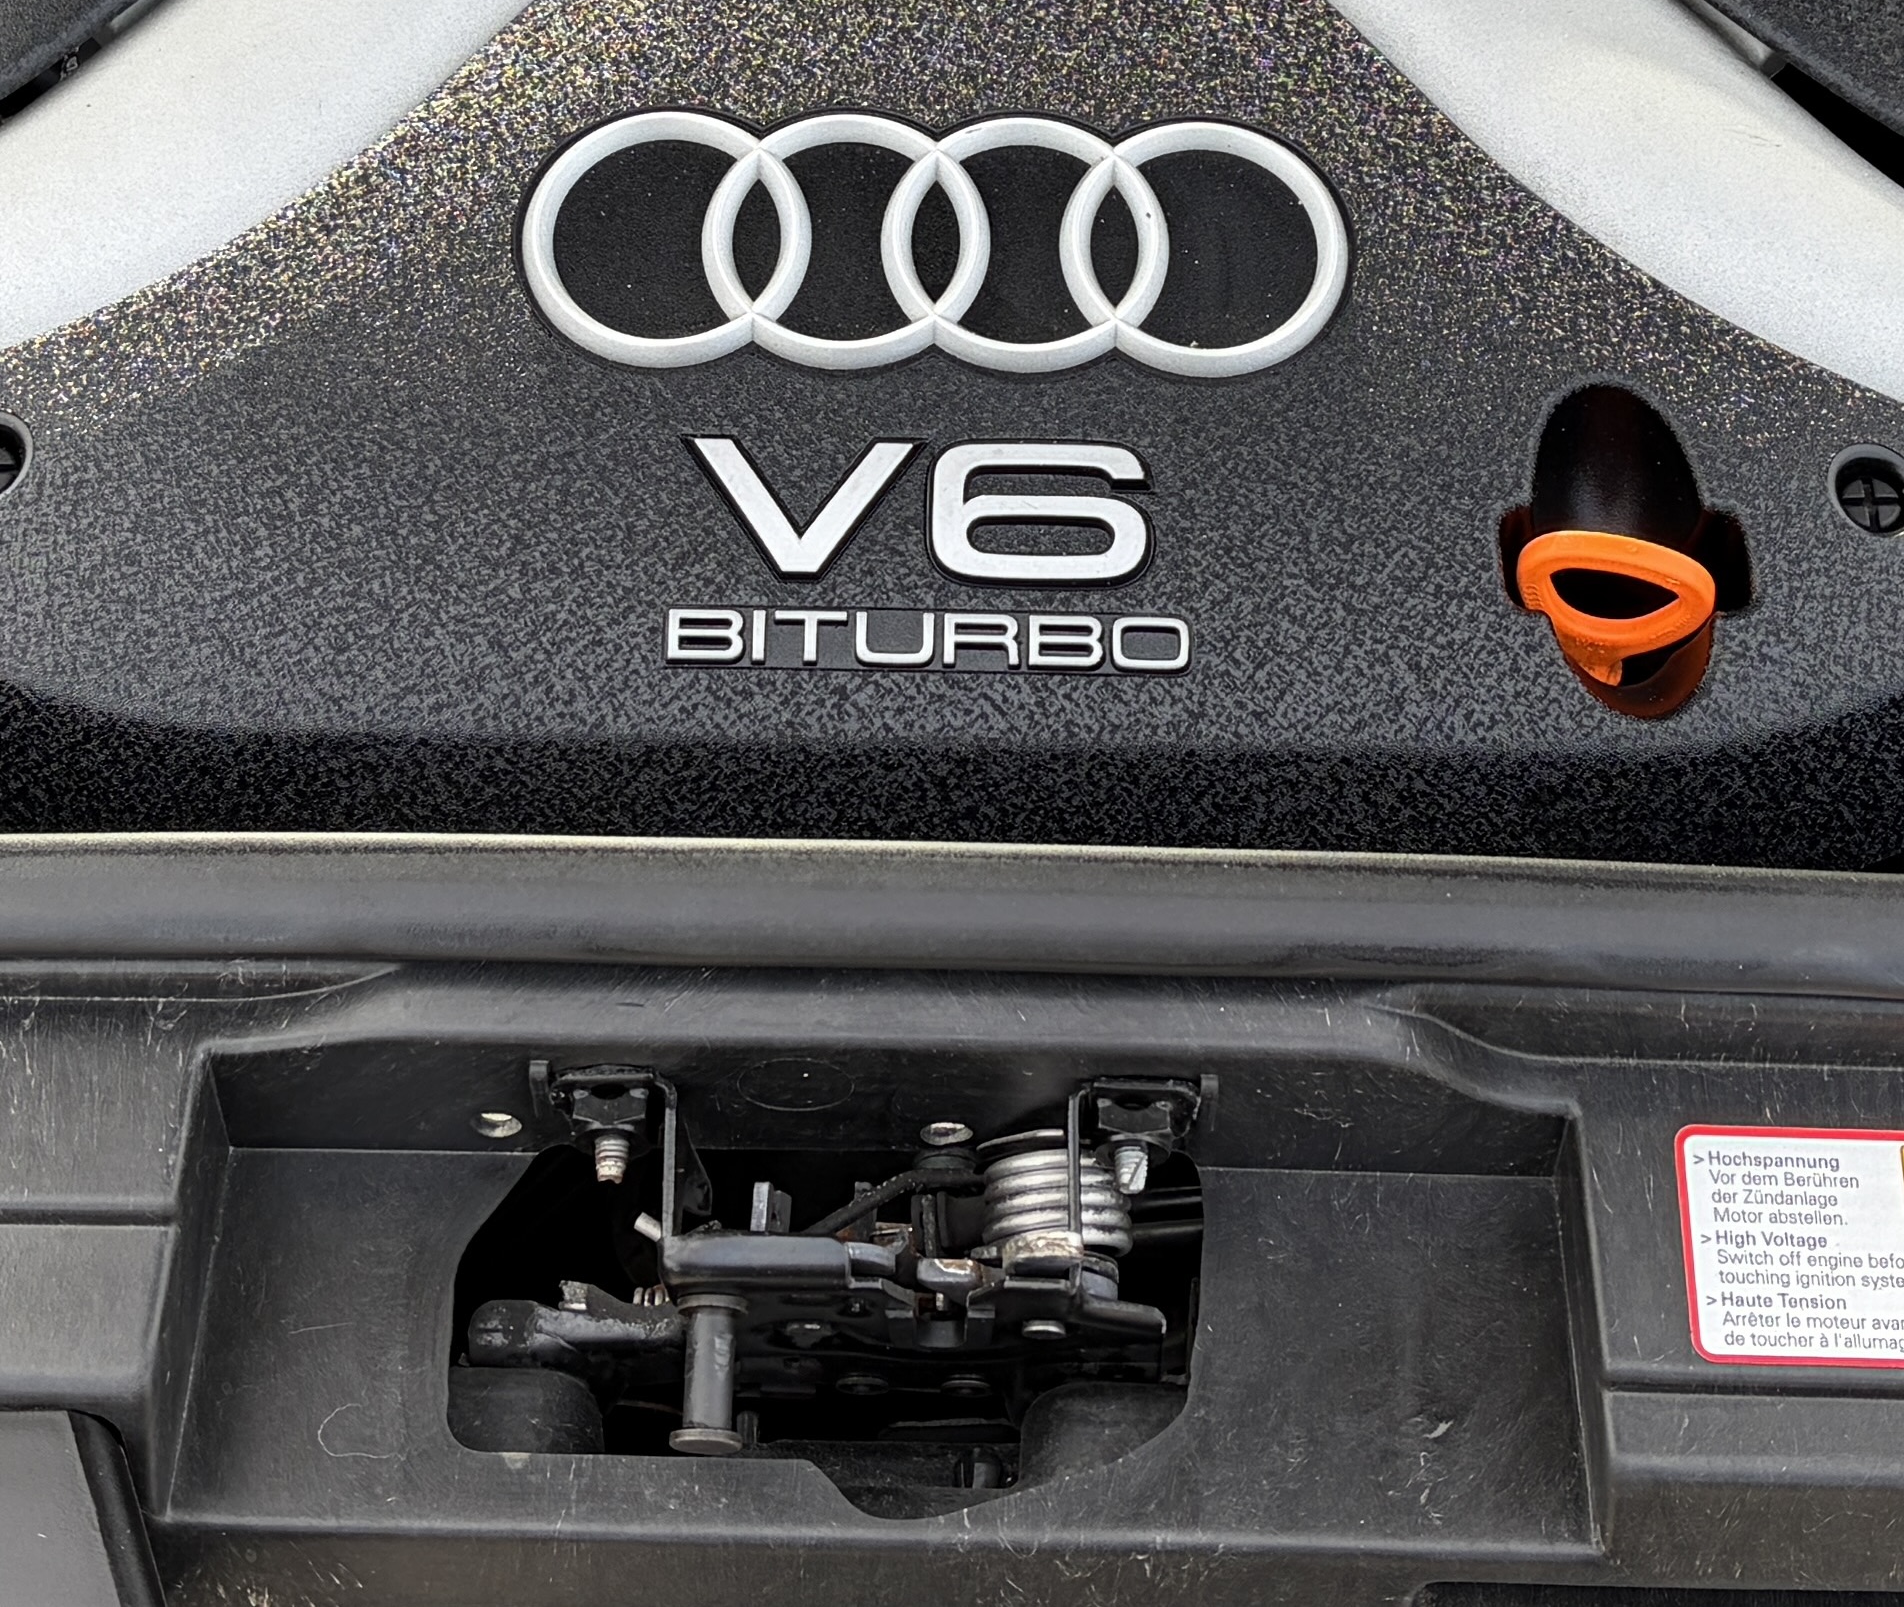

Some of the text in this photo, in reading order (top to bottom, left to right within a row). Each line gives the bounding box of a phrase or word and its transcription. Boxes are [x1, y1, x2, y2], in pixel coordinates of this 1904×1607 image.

[686, 435, 1154, 586] V6
[664, 607, 1192, 675] BITURBO
[1708, 1152, 1840, 1171] Hochspannung
[1709, 1170, 1859, 1188] Vor dem Berühren
[1712, 1190, 1838, 1207] der Zündanlage
[1714, 1208, 1848, 1225] Motor abstellen.
[1716, 1231, 1827, 1249] High Voltage
[1717, 1251, 1773, 1265] Switch
[1779, 1252, 1801, 1266] off
[1807, 1255, 1863, 1269] engine
[1719, 1271, 1790, 1286] touching
[1796, 1271, 1855, 1288] ignition
[1721, 1292, 1846, 1310] Haute Tension
[1723, 1312, 1780, 1327] Arrêter
[1786, 1313, 1801, 1328] le
[1807, 1317, 1866, 1329] moteur
[1725, 1333, 1745, 1345] de
[1750, 1333, 1814, 1347] toucher
[1820, 1334, 1829, 1348] à
